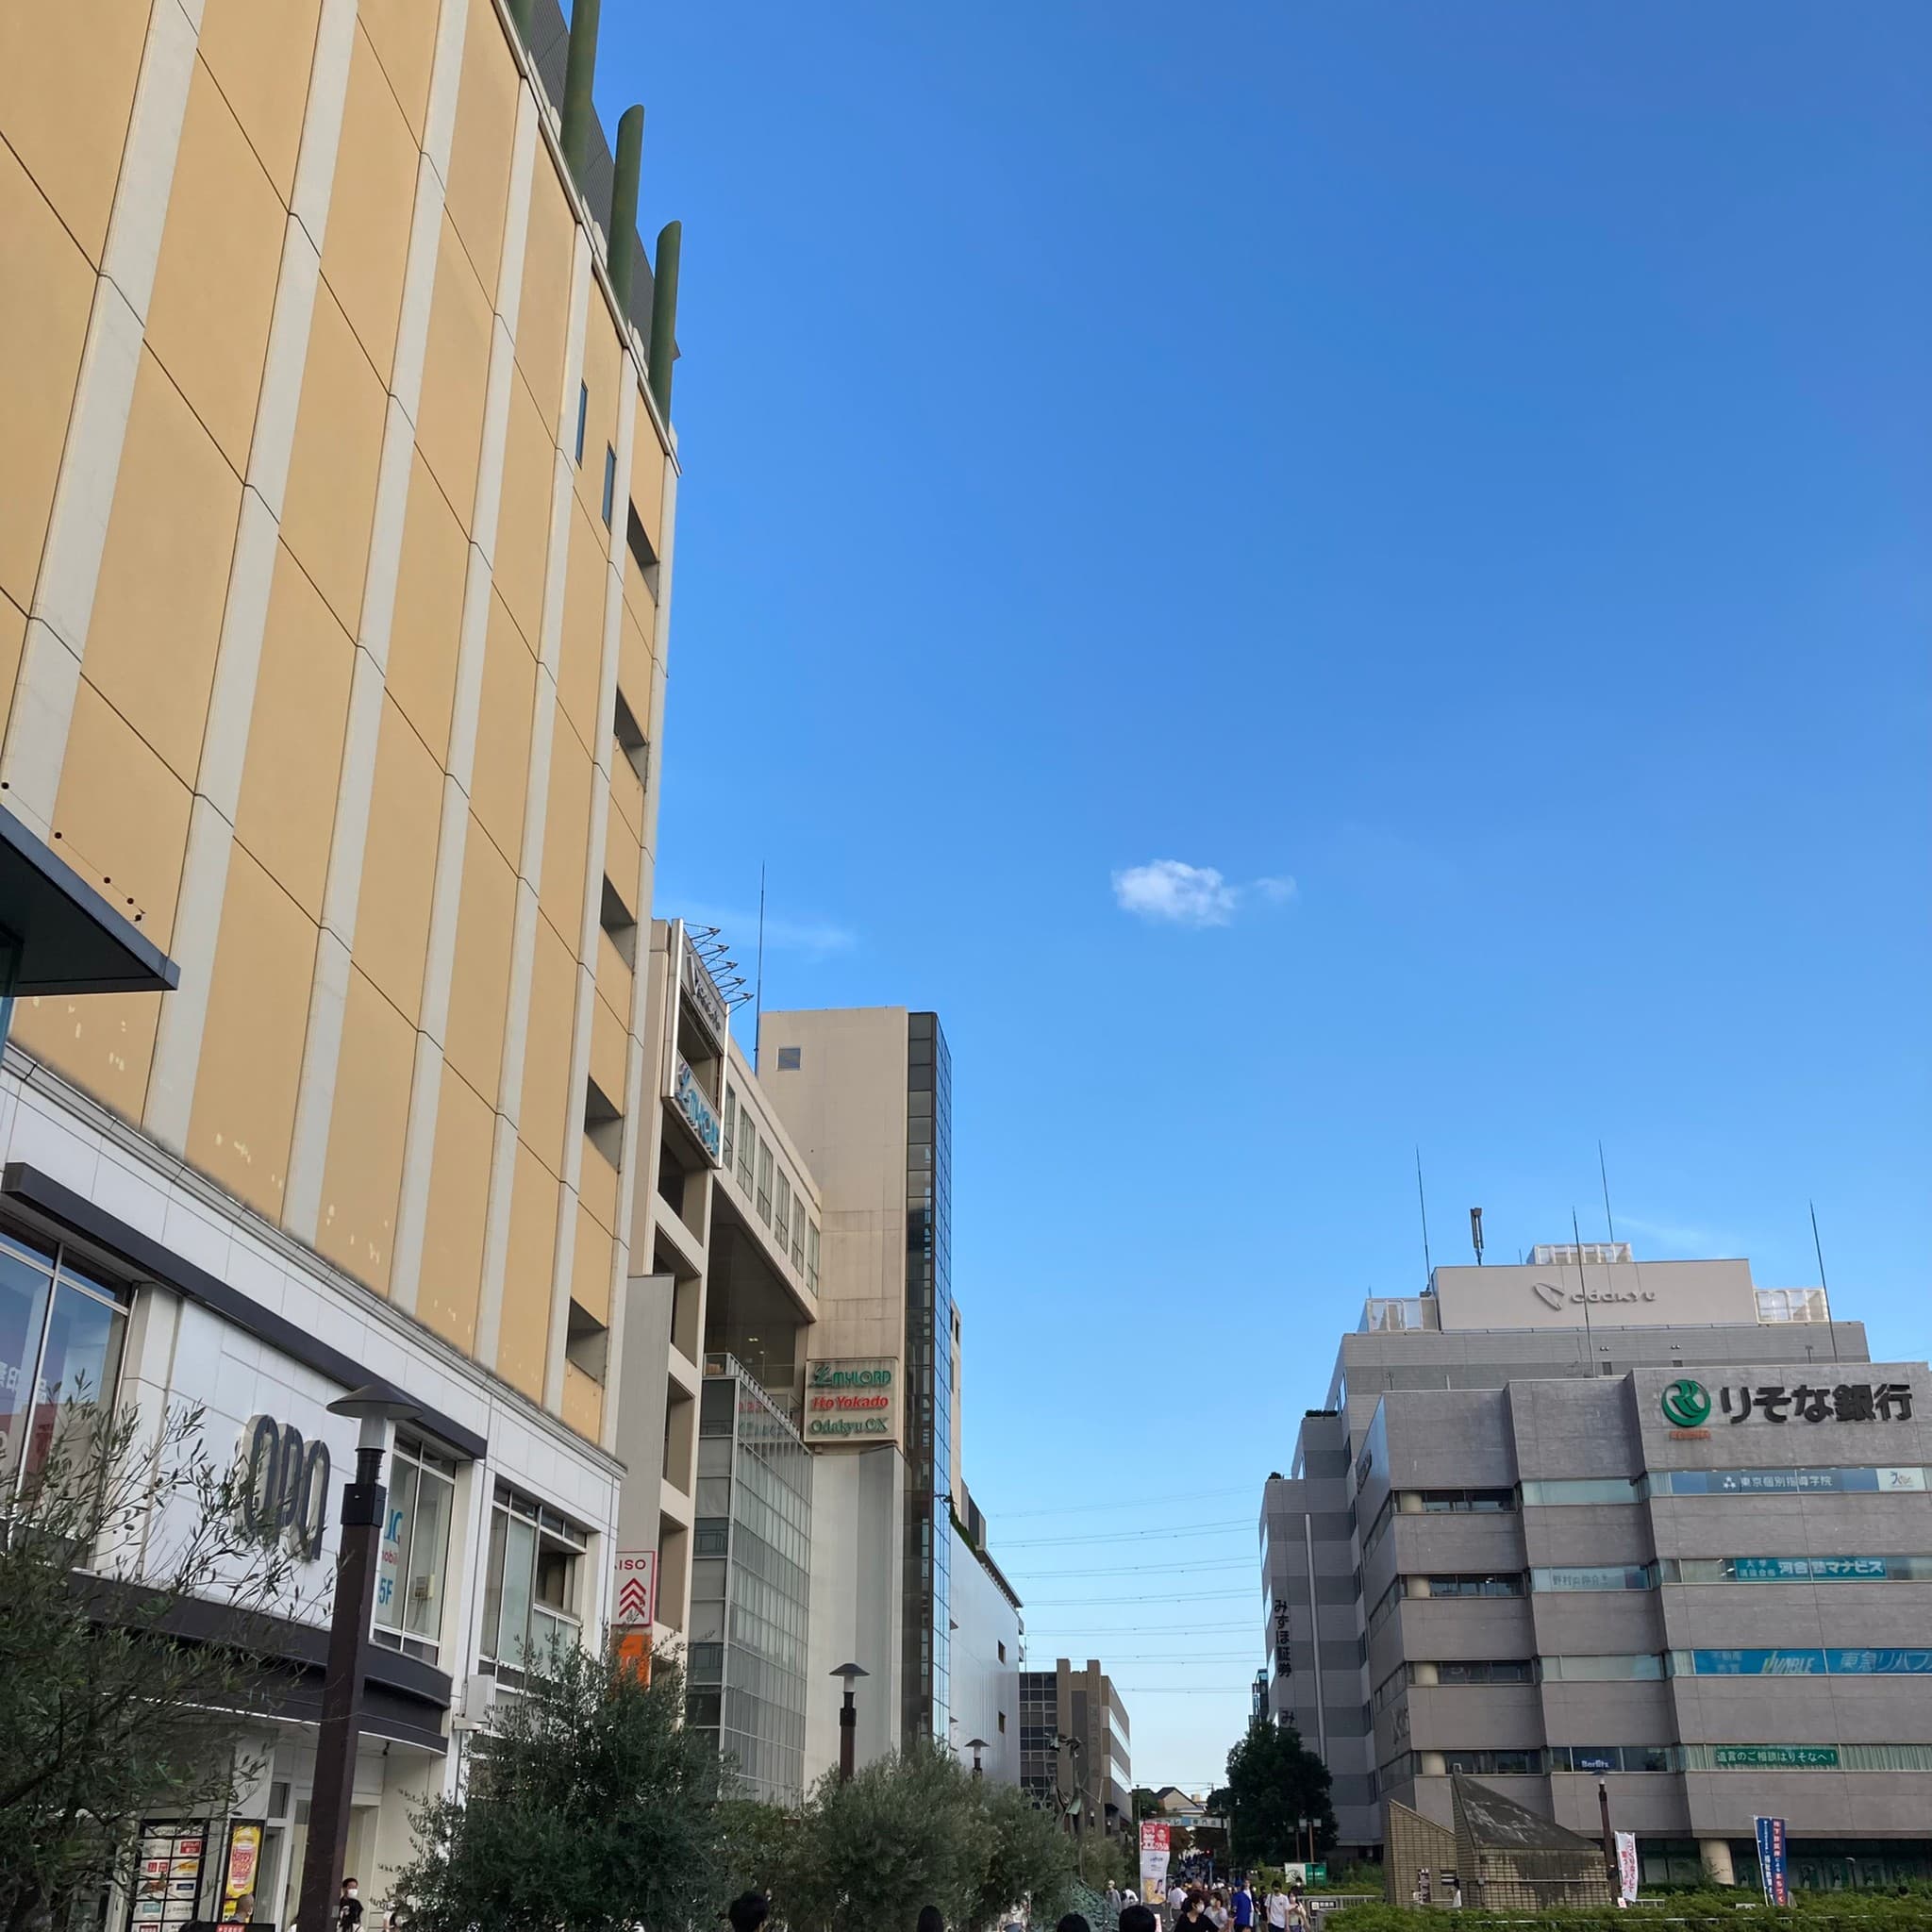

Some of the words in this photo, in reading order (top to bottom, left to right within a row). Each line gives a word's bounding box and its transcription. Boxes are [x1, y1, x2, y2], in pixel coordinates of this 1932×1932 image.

[837, 1395, 889, 1410] Yokado
[1720, 1383, 1913, 1424] りそな銀行
[810, 1418, 862, 1437] Odakyu
[865, 1417, 889, 1432] OX
[614, 1559, 646, 1571] ISO
[1778, 1560, 1884, 1574] 河合塾マナビス
[379, 1577, 393, 1606] 5F
[1274, 1599, 1291, 1677] みずほ証券
